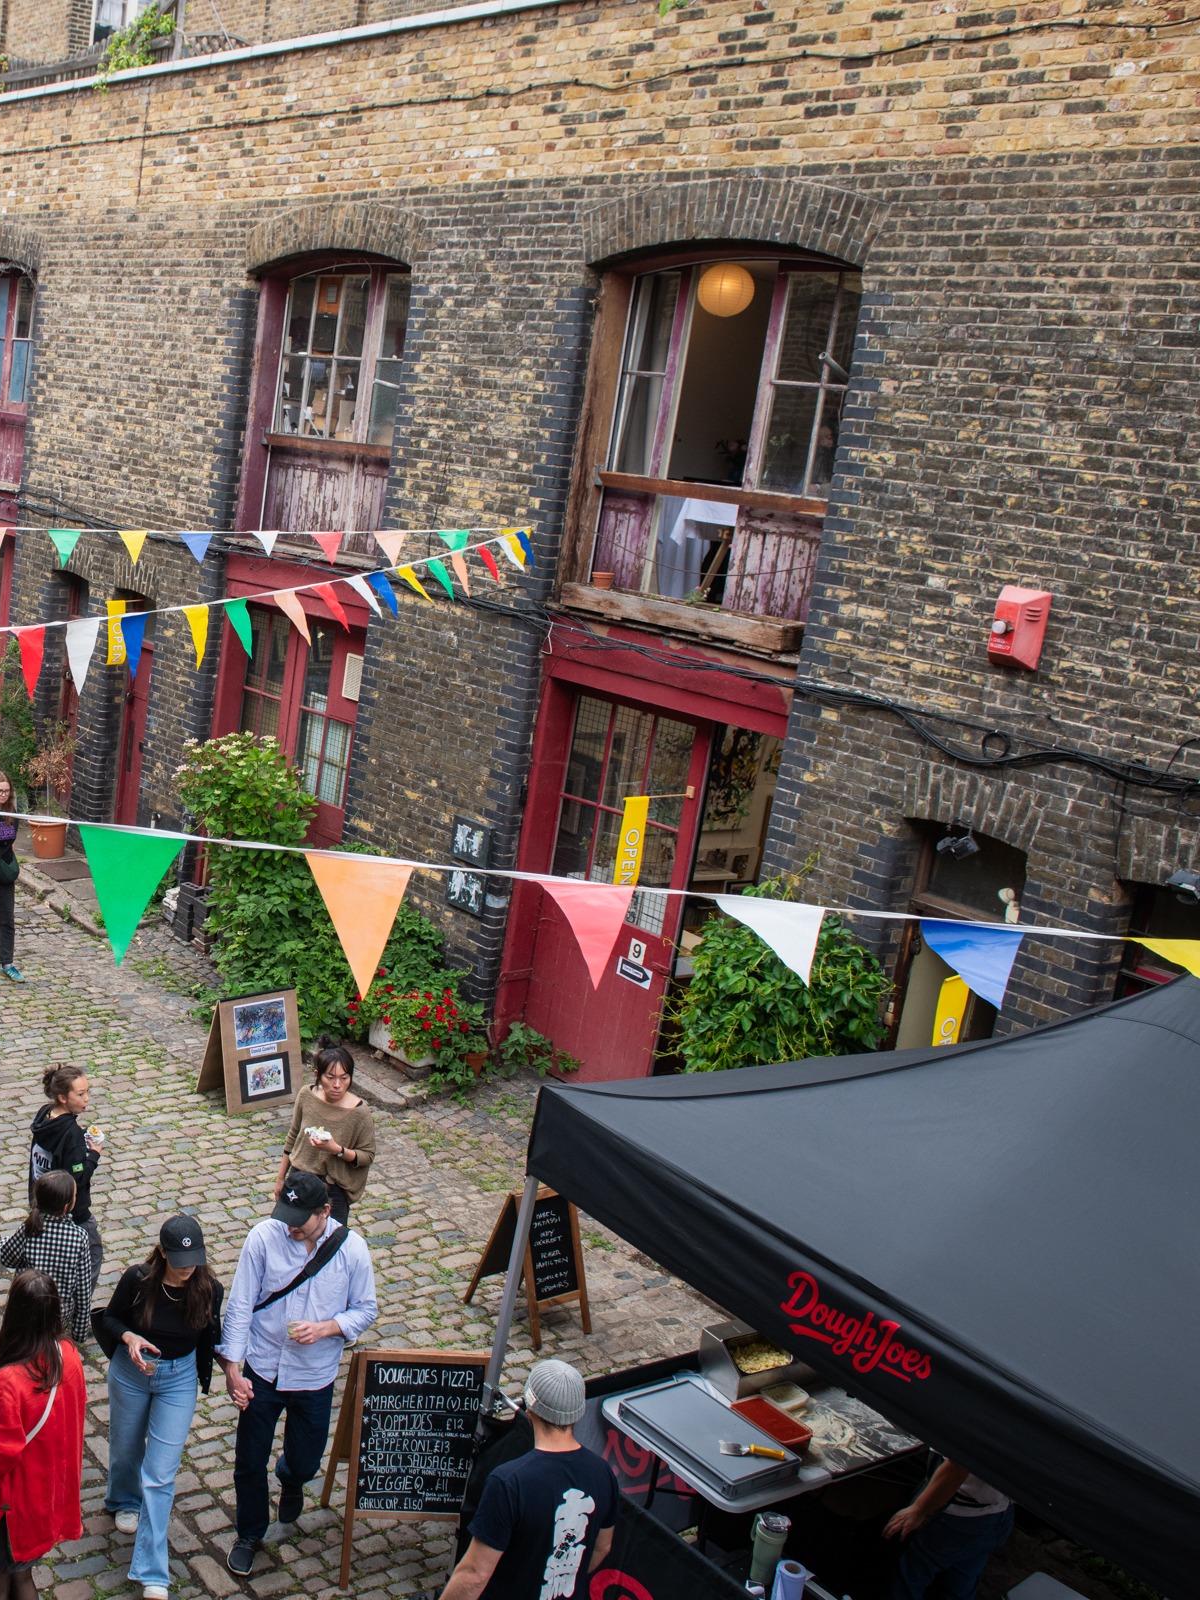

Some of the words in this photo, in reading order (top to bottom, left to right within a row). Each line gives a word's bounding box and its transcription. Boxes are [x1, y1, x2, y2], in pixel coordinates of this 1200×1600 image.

[112, 622, 123, 663] OPEN
[618, 828, 640, 885] OPEN
[632, 943, 642, 959] 9
[780, 1271, 931, 1380] DoughJoes
[441, 1369, 475, 1388] PIZZA
[370, 1394, 445, 1410] MARGHERITA
[367, 1453, 402, 1468] SPICY
[359, 1496, 385, 1510] GARLIC
